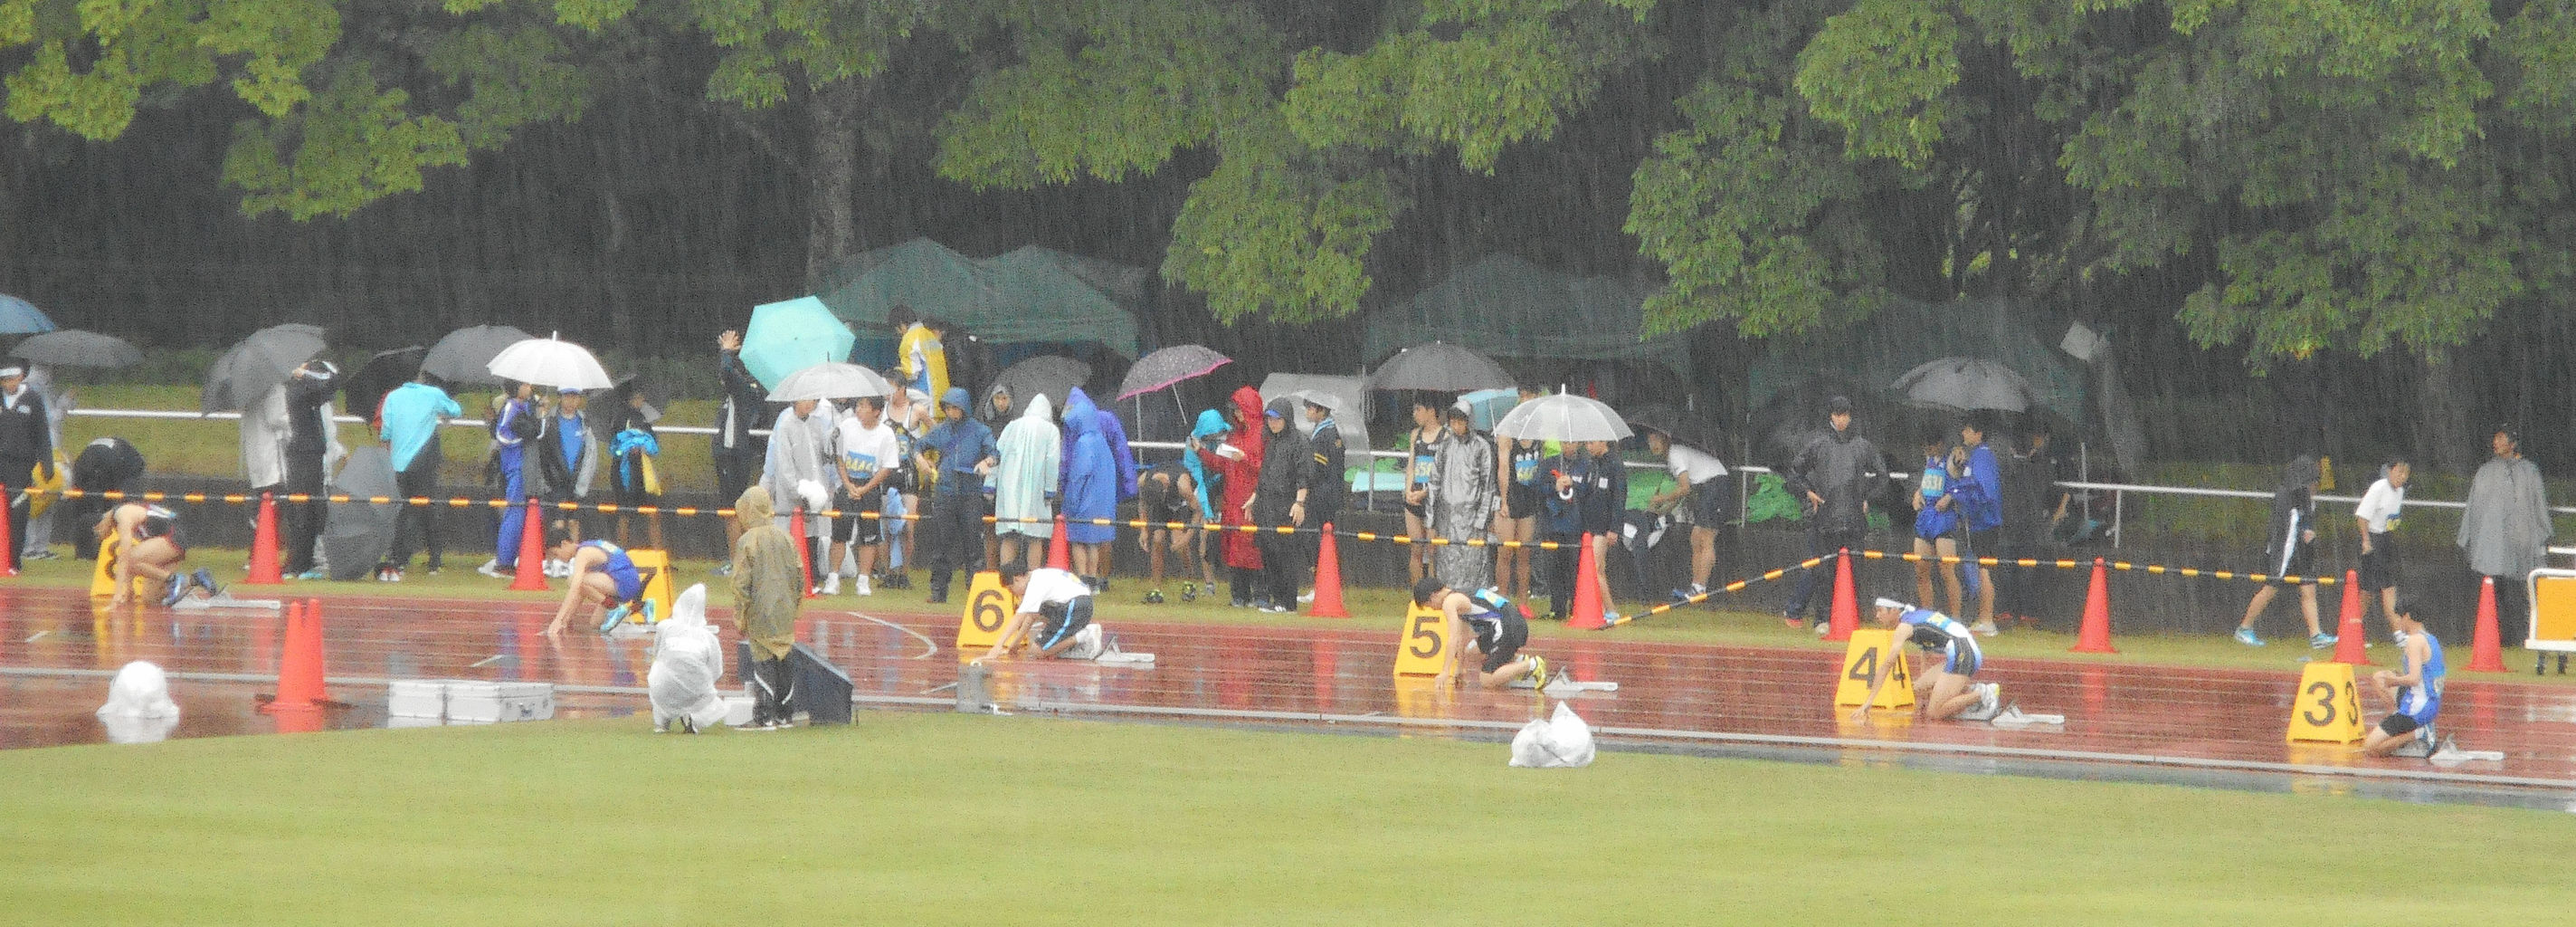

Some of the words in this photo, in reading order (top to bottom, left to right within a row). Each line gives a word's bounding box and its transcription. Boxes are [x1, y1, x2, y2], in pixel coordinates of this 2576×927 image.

[634, 566, 657, 602] 7
[973, 589, 1004, 632] 6
[1410, 616, 1441, 659] 5
[1849, 646, 1877, 690] 4
[2304, 681, 2335, 727] 3
[2344, 681, 2358, 727] 3
